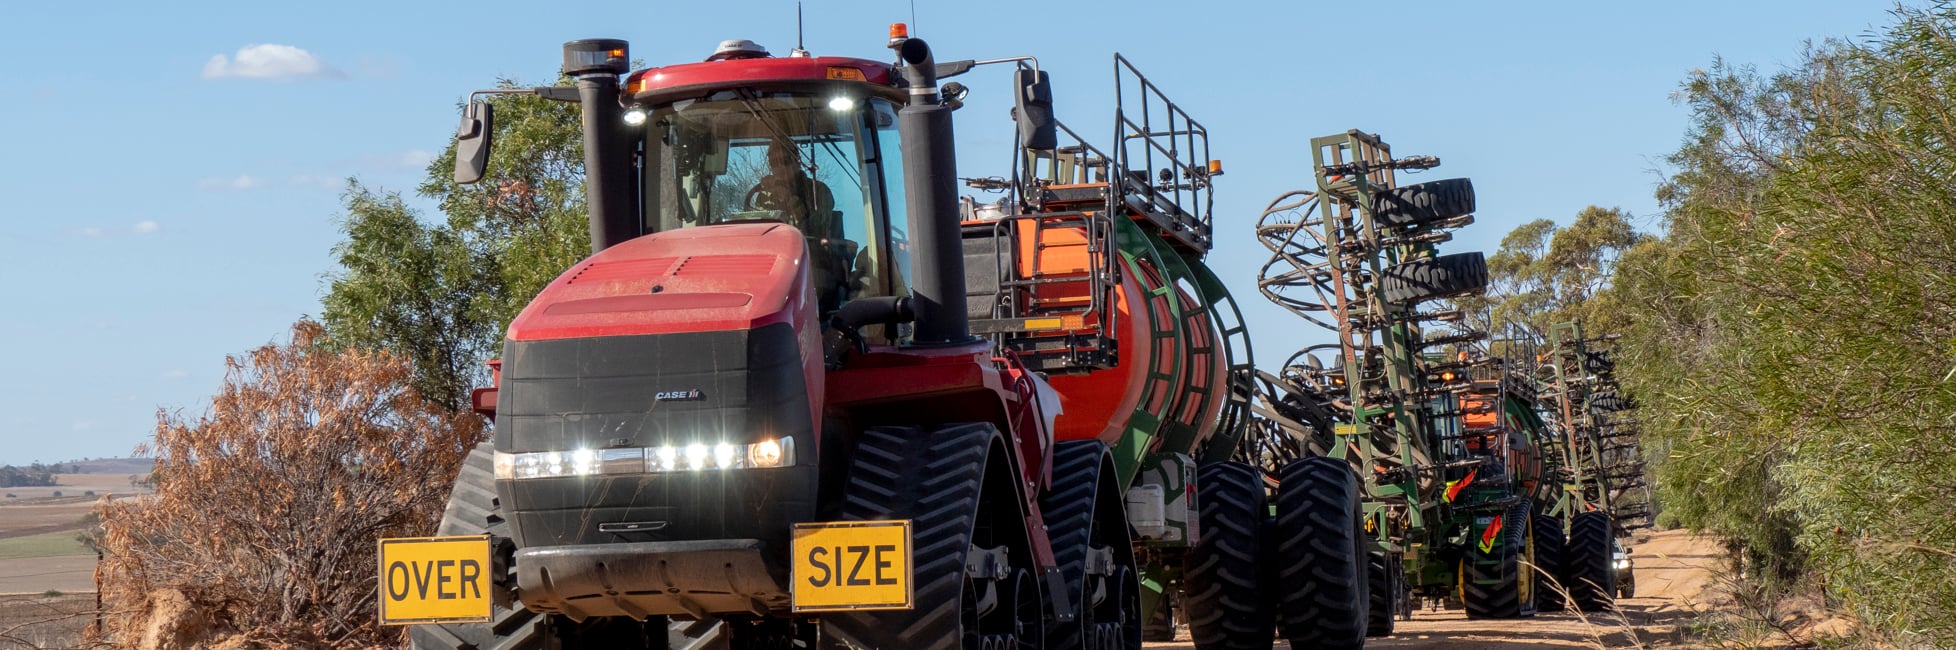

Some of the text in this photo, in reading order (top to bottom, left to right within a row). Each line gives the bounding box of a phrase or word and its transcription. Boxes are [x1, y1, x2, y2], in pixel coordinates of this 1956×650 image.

[655, 391, 687, 399] CASE
[388, 559, 481, 602] OVER
[808, 545, 897, 588] SIZE
